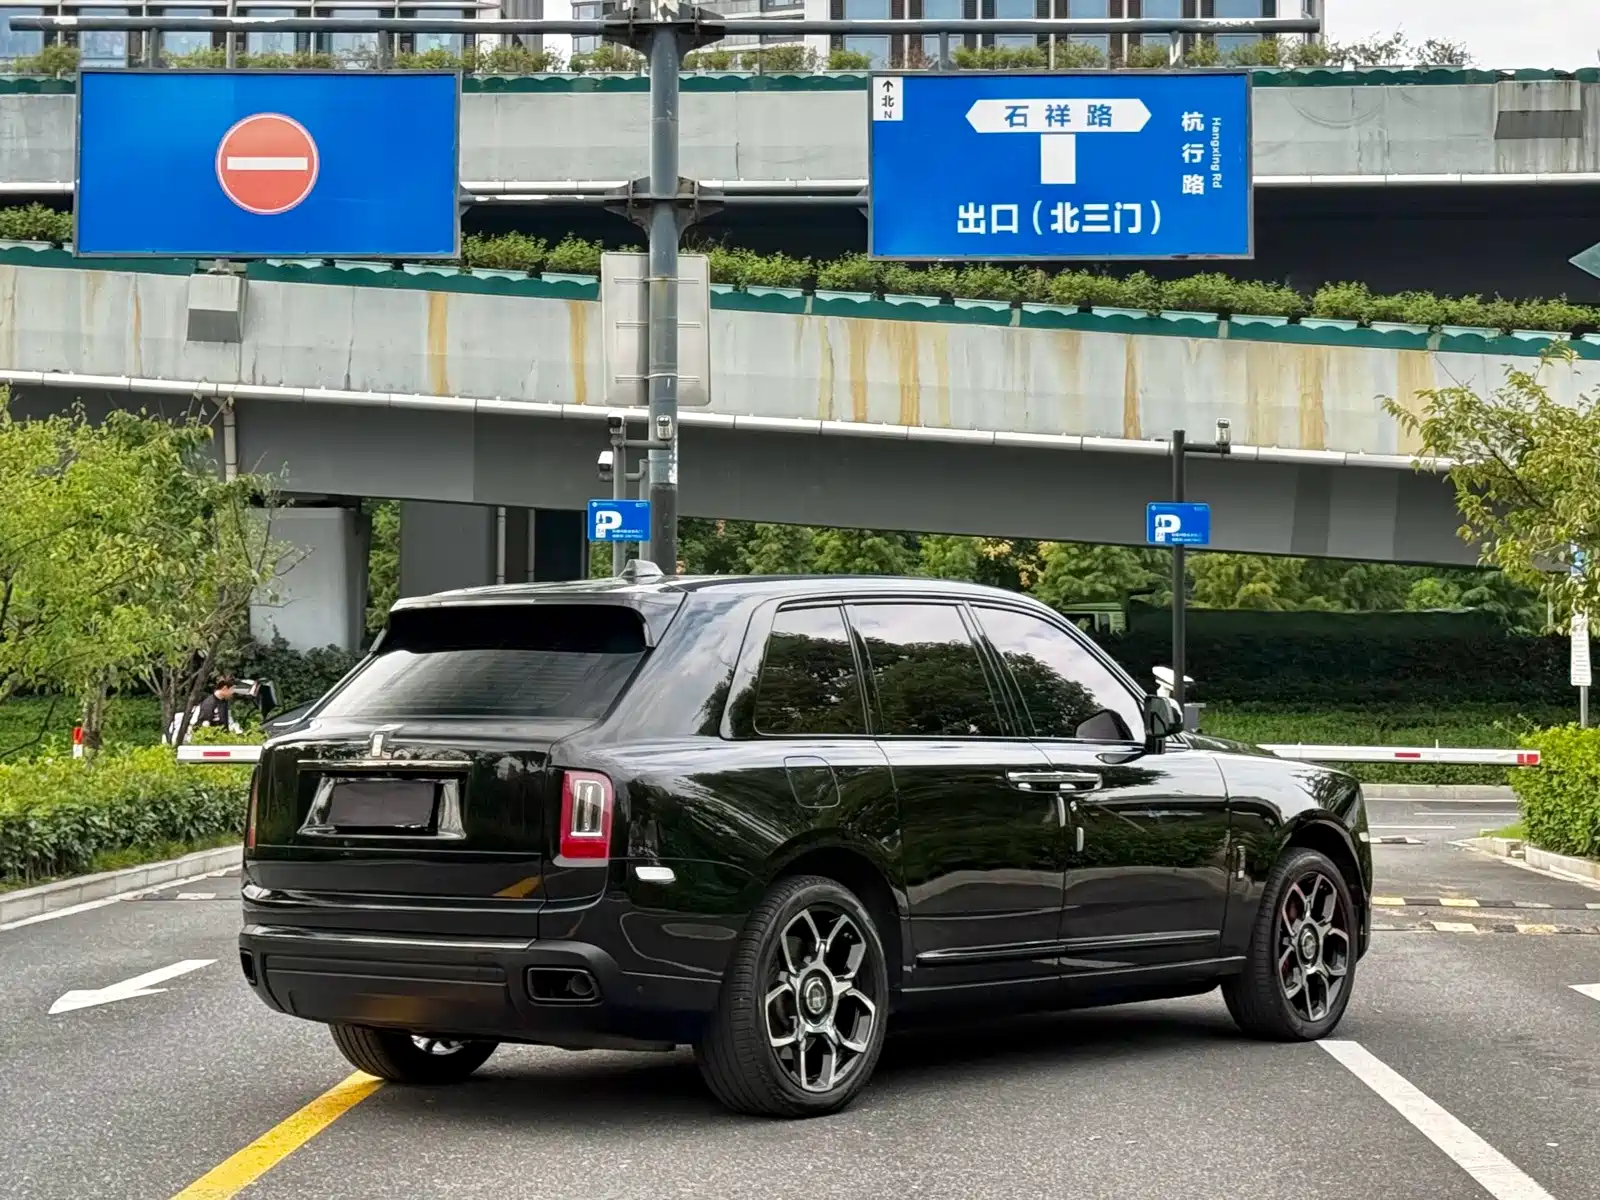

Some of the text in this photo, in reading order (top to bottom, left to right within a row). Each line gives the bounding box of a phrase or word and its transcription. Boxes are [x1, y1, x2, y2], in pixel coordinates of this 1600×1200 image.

[881, 94, 894, 107] 北
[882, 110, 893, 119] N
[1004, 104, 1113, 128] 石祥路
[1181, 111, 1205, 195] 杭行路
[1210, 117, 1222, 188] Hangxing Rd
[595, 510, 622, 538] P
[1154, 514, 1181, 541] P
